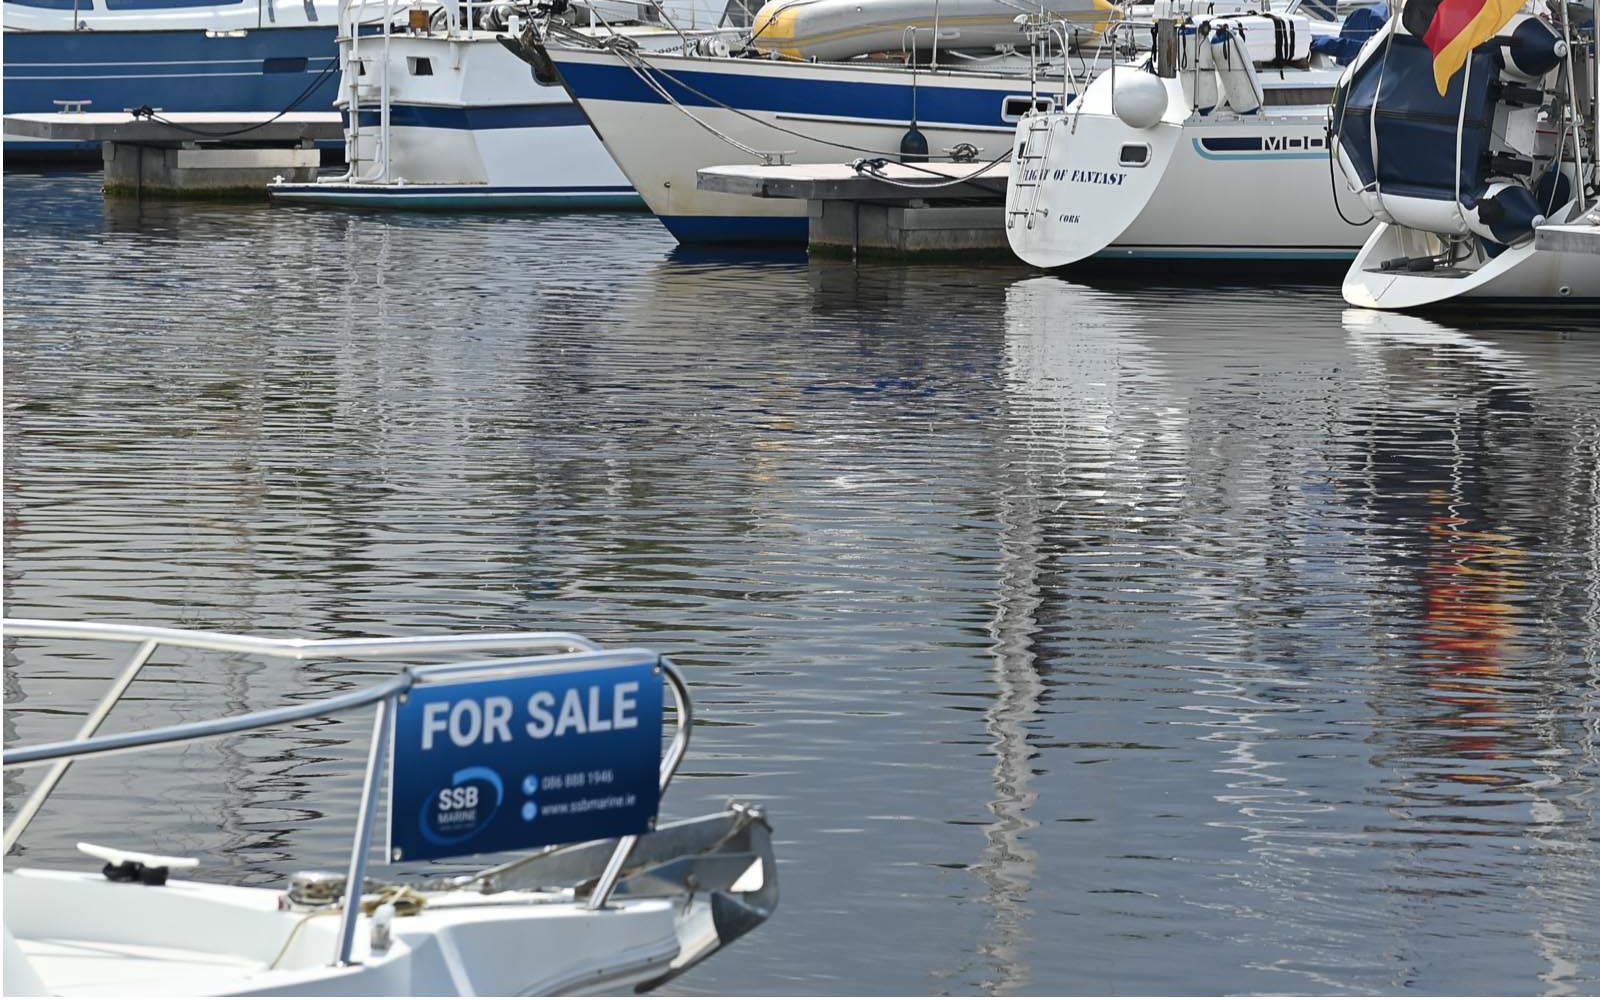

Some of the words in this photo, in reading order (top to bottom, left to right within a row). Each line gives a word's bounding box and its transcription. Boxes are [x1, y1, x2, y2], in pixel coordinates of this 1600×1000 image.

[1053, 168, 1069, 181] OF
[1071, 169, 1127, 186] FANTASY
[1058, 213, 1081, 224] CORK
[421, 697, 514, 751] FOR
[525, 681, 640, 740] SALE
[541, 774, 563, 791] 086
[438, 785, 479, 811] SSB
[541, 792, 637, 816] www.ssbmarine.ie
[437, 810, 477, 825] MARINE
